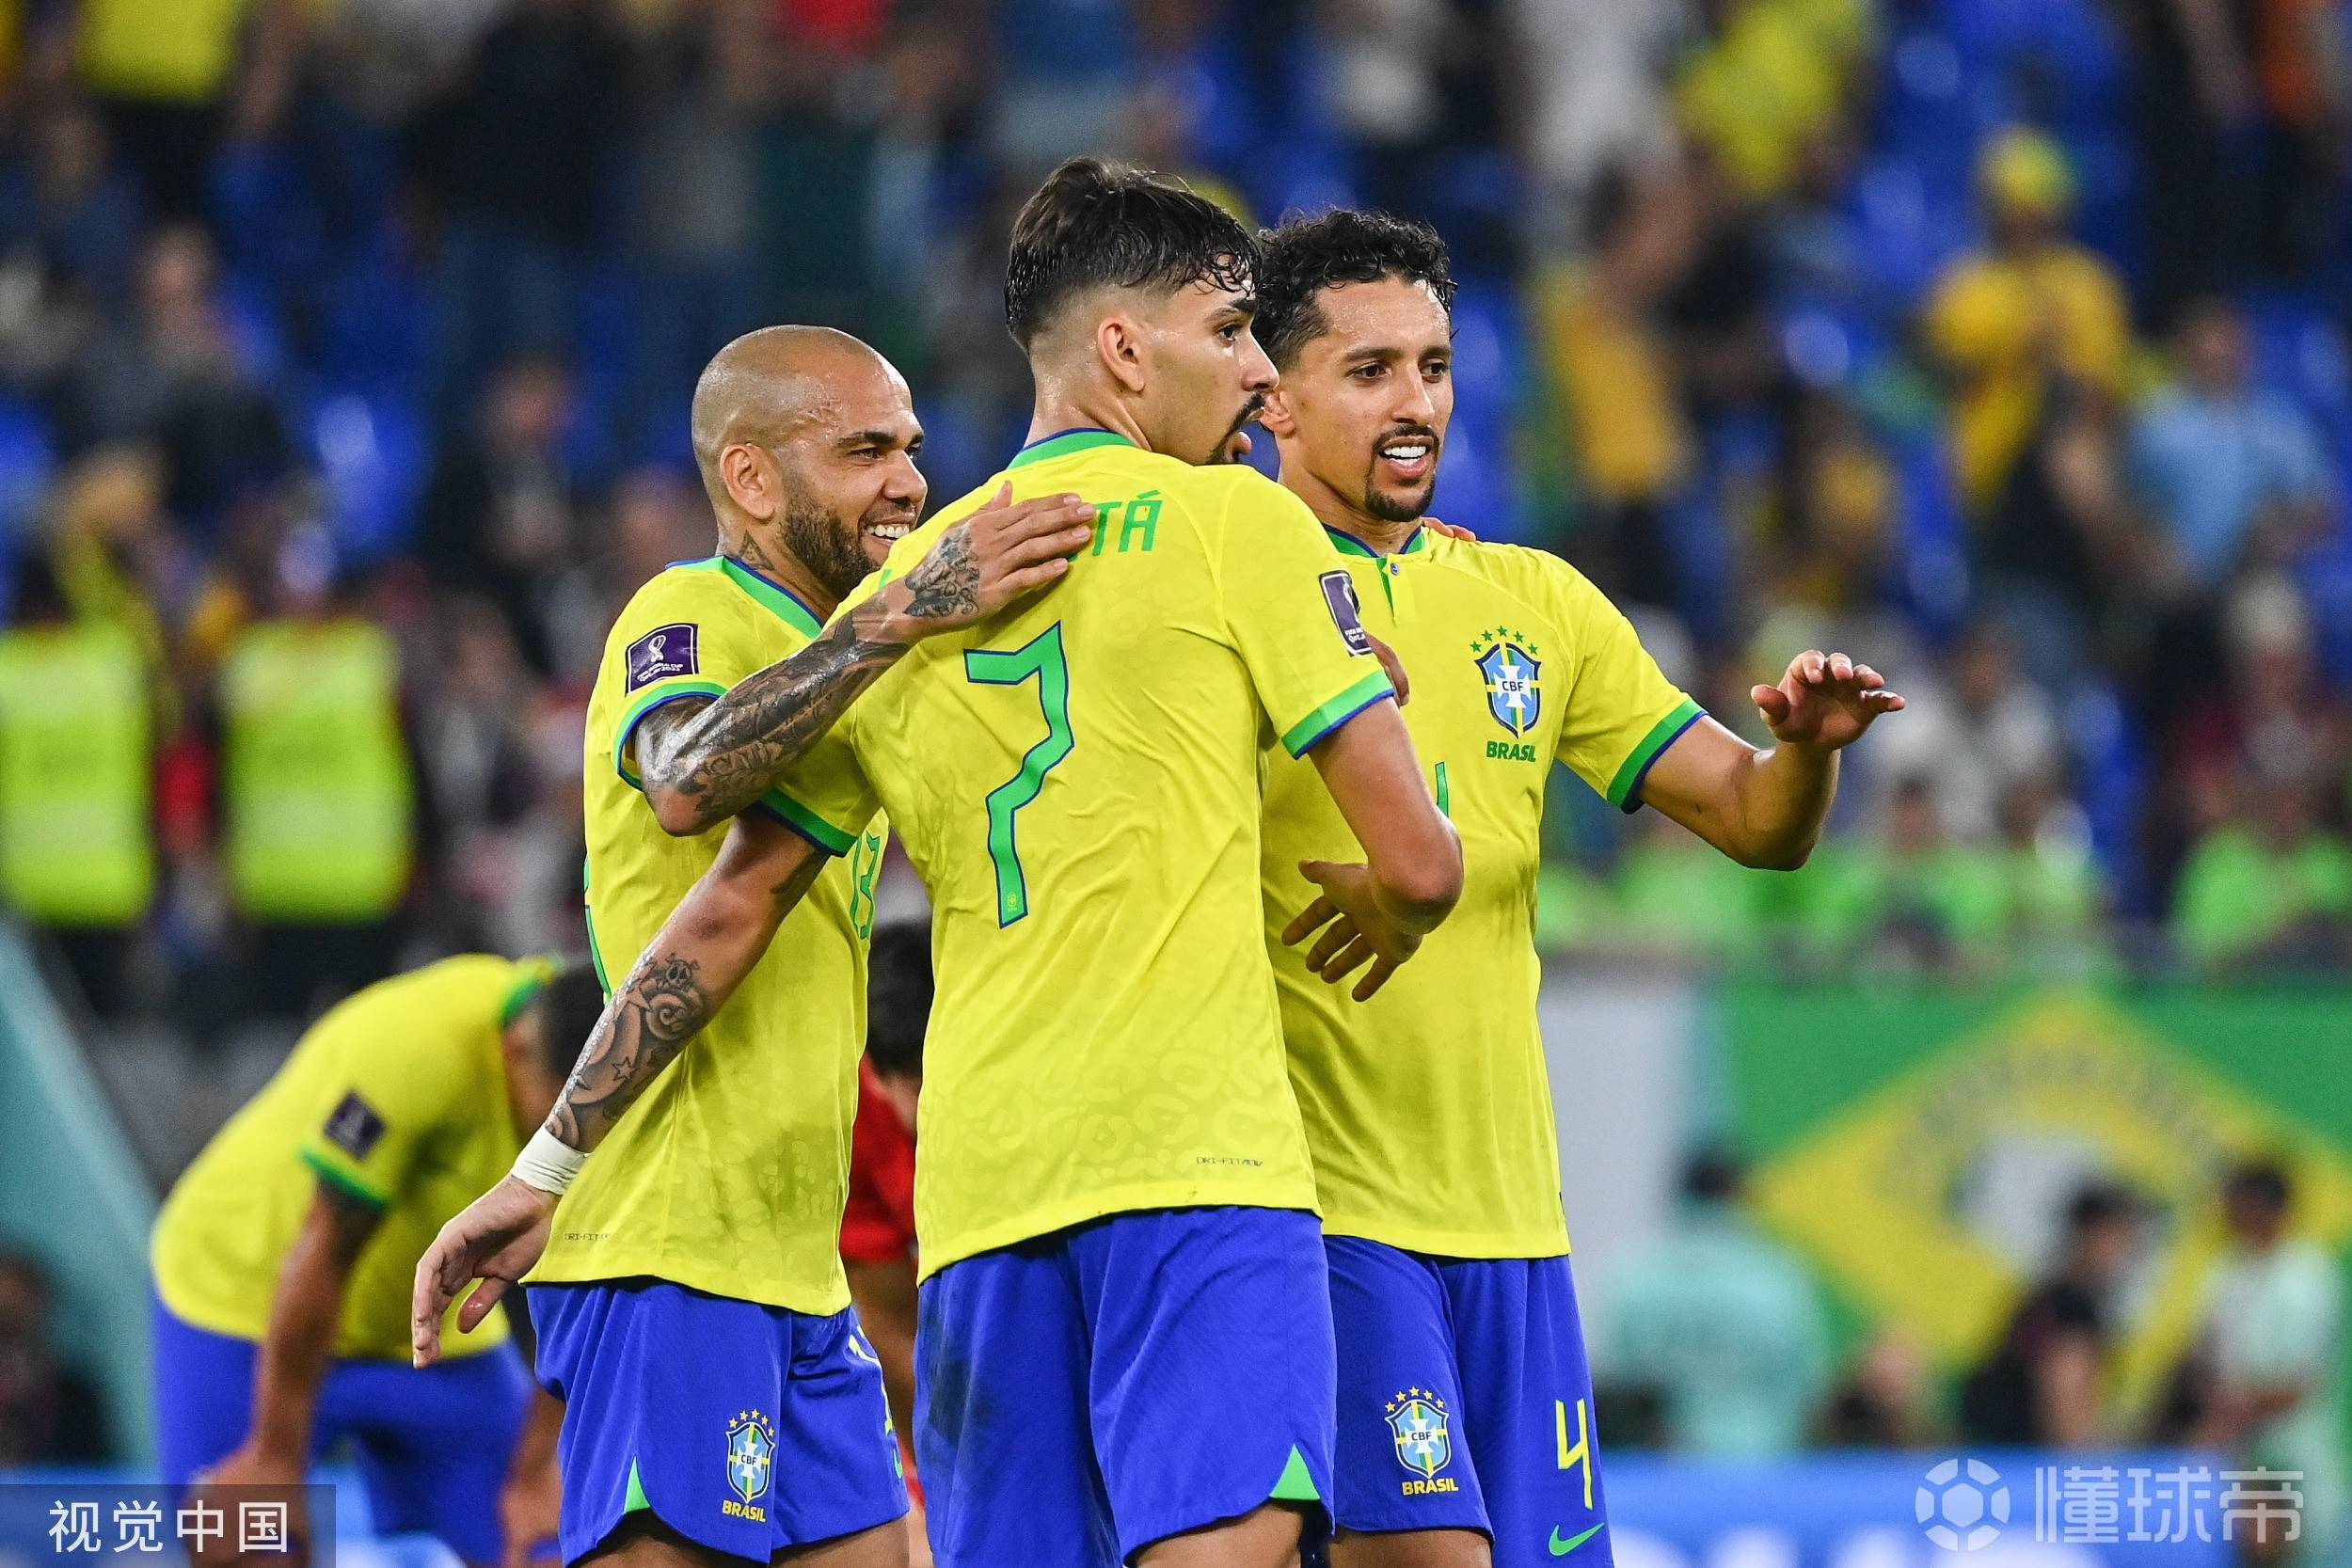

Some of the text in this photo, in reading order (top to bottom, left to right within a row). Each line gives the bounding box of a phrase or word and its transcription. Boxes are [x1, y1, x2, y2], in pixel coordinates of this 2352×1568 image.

[1502, 680, 1524, 692] CBF
[1486, 740, 1536, 763] BRASIL
[963, 619, 1075, 930] 7
[1411, 1431, 1432, 1442] CBF
[740, 1453, 757, 1465] CBF
[1555, 1398, 1594, 1511] 4
[1402, 1478, 1459, 1496] BRASIL
[722, 1499, 767, 1523] BRASIL
